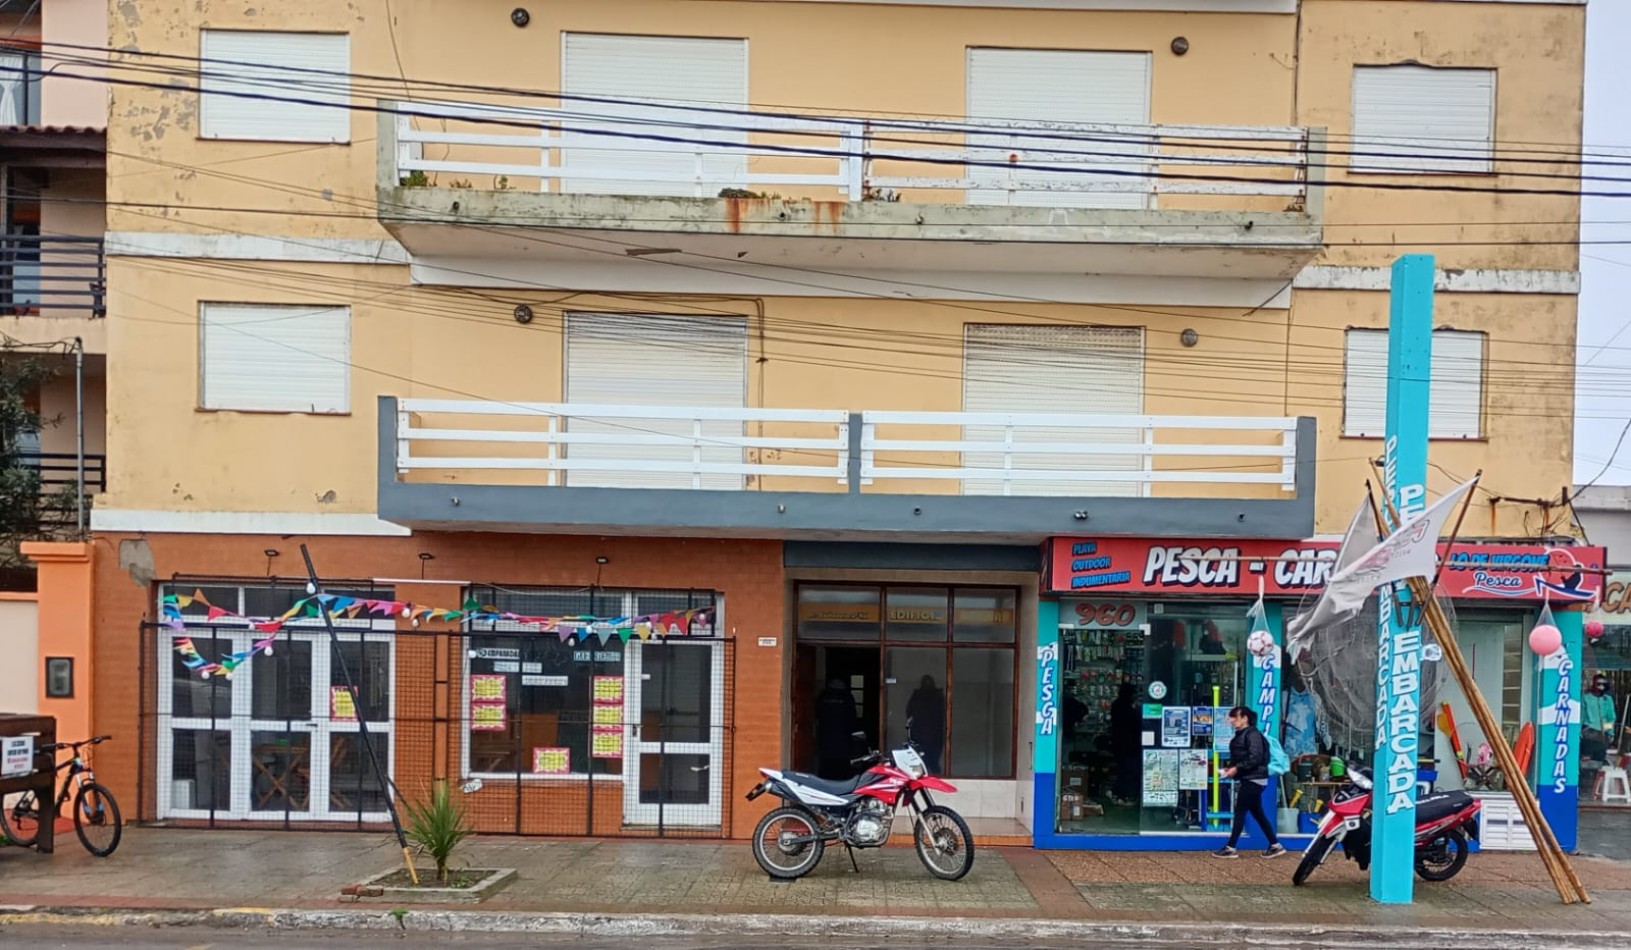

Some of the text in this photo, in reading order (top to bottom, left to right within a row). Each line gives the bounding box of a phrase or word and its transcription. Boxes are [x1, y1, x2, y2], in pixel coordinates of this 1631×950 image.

[1072, 557, 1111, 572] OUTDOOR
[1072, 571, 1131, 589] INDUMENTARIA
[1143, 546, 1240, 586] PESCA
[1274, 549, 1337, 586] CAR
[1450, 553, 1469, 570] LO
[1470, 553, 1489, 570] DE
[1474, 571, 1521, 588] Pesca
[1075, 603, 1135, 627] 960
[1375, 585, 1392, 750] MBARCADA
[1041, 650, 1054, 735] PESCA
[1259, 653, 1276, 737] CAMPI
[1387, 630, 1420, 815] EMBARCADA
[1554, 660, 1573, 794] CARNADAS
